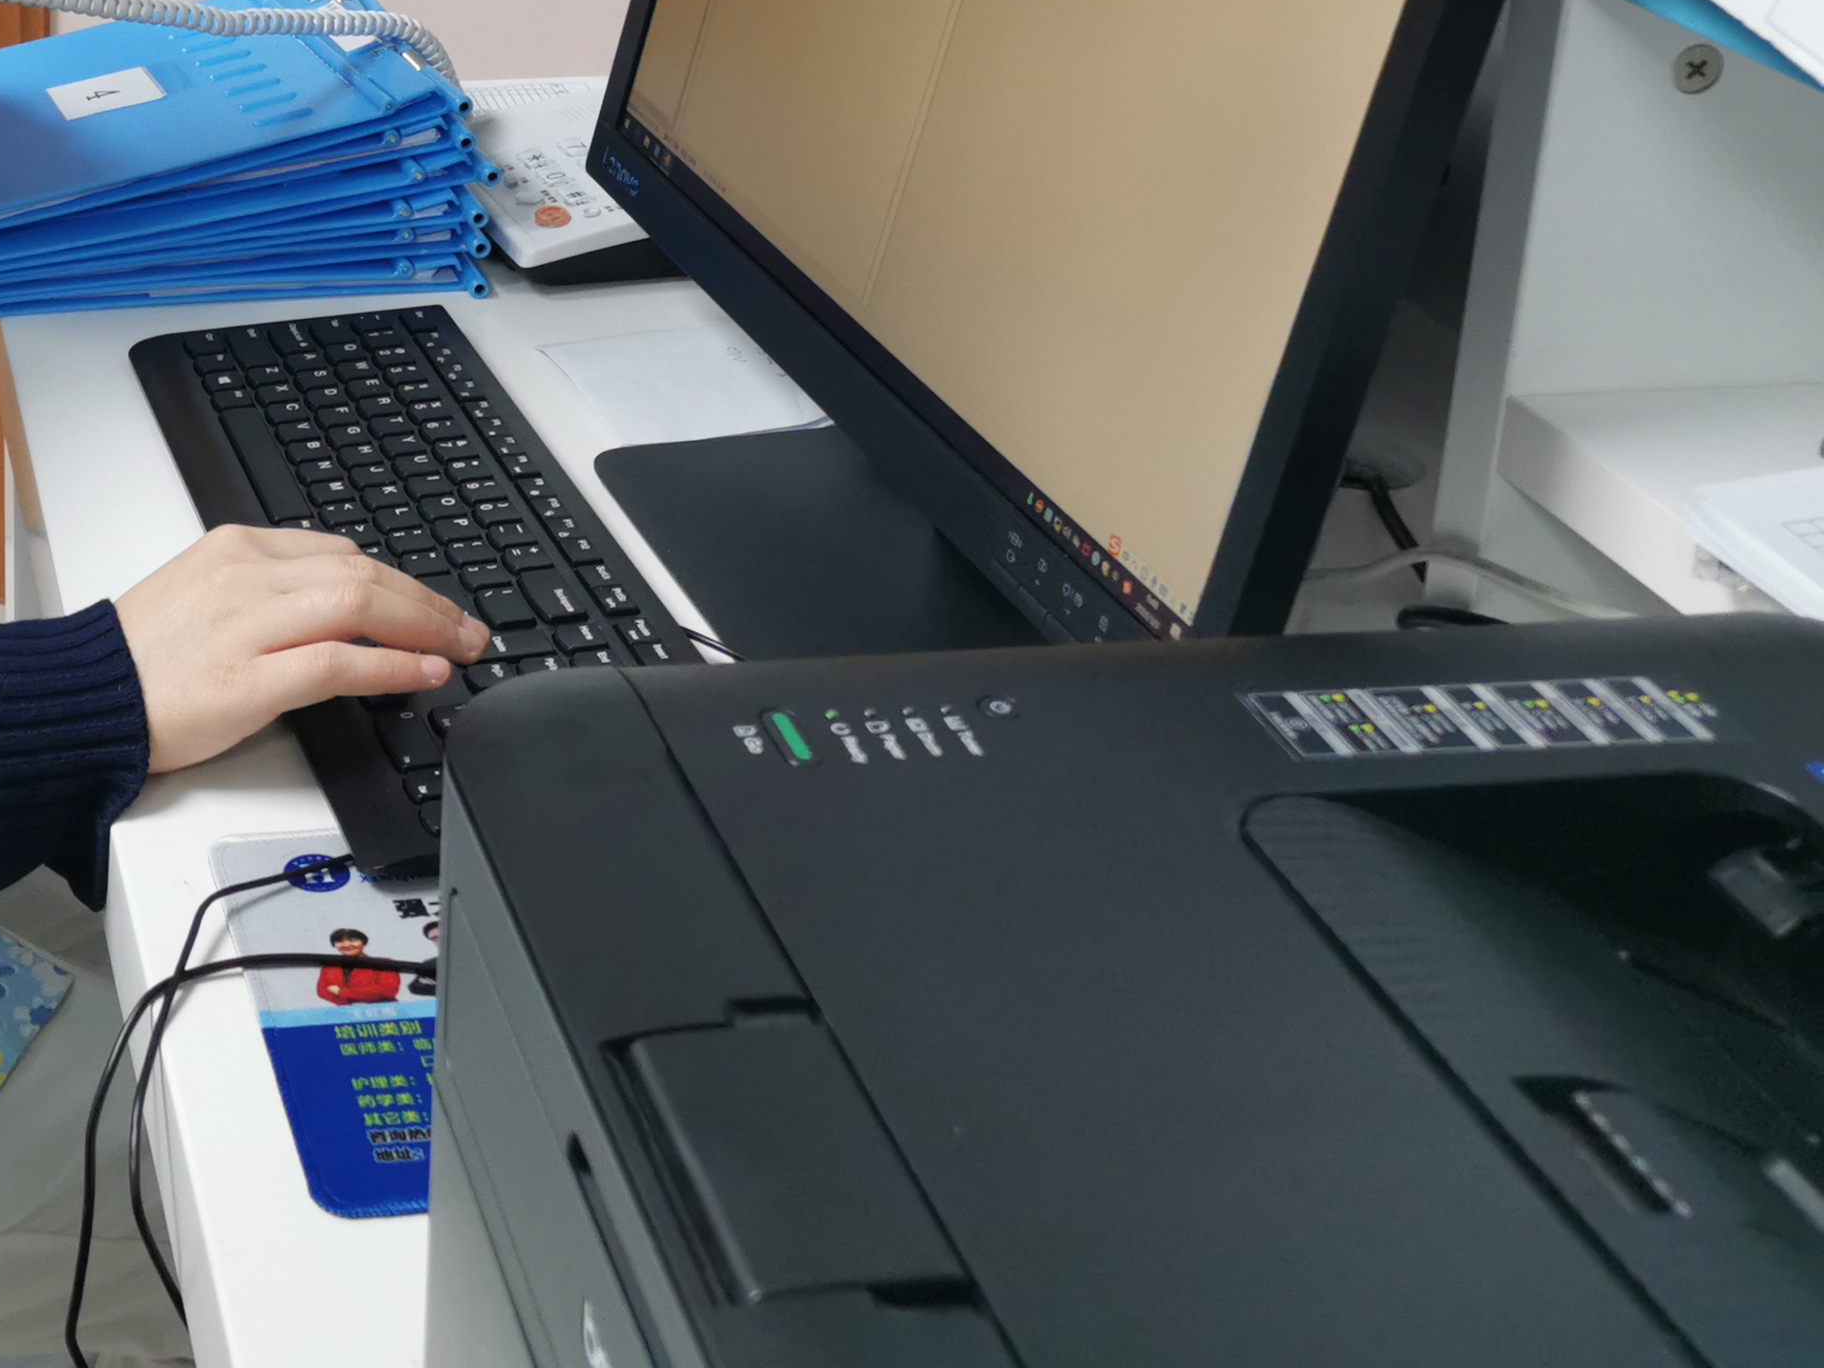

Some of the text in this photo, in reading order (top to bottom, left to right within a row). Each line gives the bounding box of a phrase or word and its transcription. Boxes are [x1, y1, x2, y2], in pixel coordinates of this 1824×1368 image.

[265, 366, 279, 374] Z
[275, 384, 289, 392] X
[317, 460, 332, 469] N
[328, 481, 344, 491] M
[347, 426, 361, 434] G
[358, 445, 373, 453] H
[382, 485, 397, 494] K
[395, 507, 409, 515] L
[355, 361, 370, 369] W
[377, 397, 391, 405] R
[401, 435, 416, 443] Y
[414, 455, 428, 463] U
[441, 497, 455, 505] O
[453, 518, 469, 526] P
[334, 1020, 423, 1040] 培训类别
